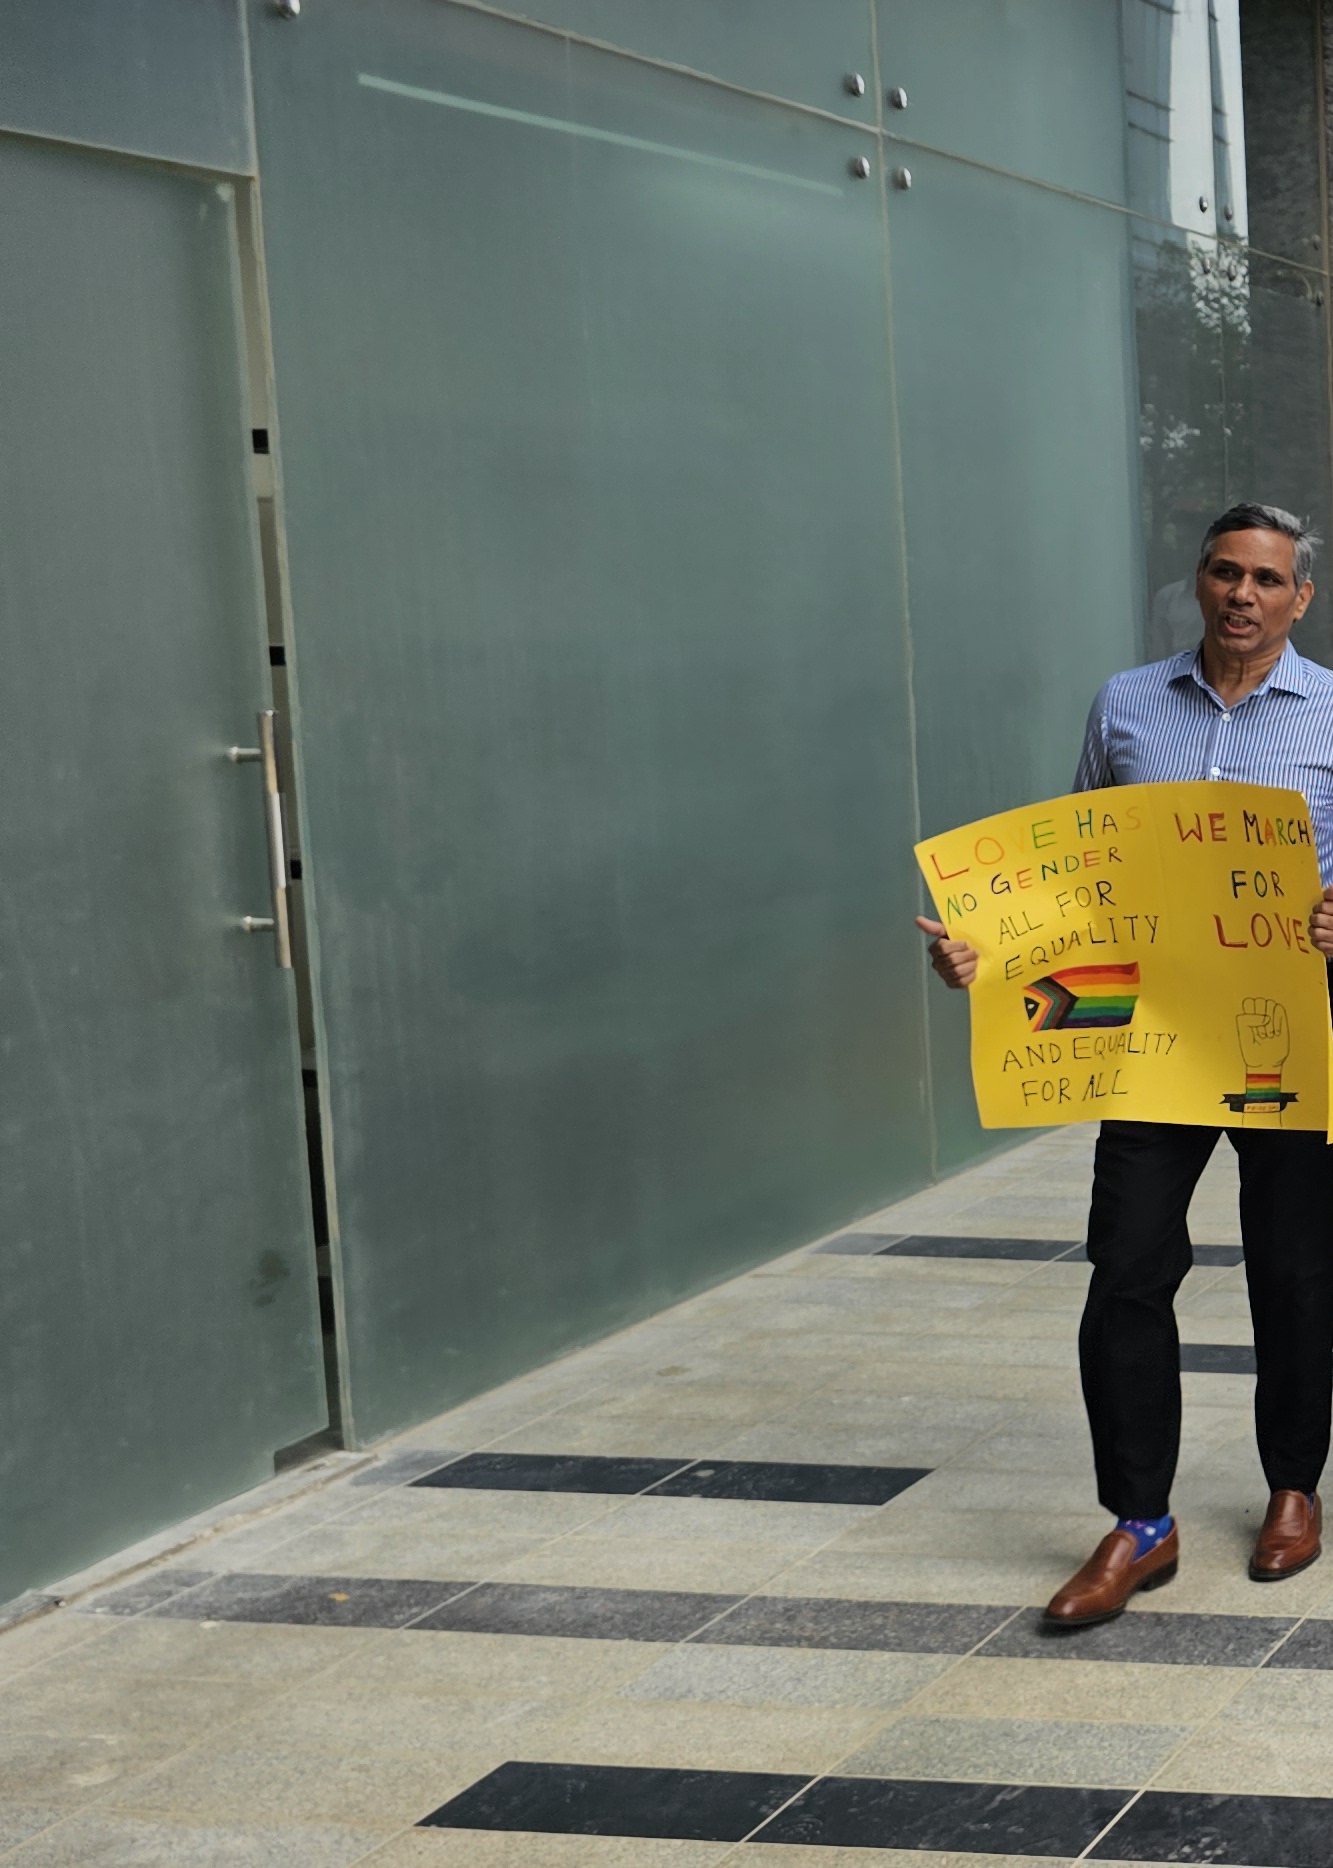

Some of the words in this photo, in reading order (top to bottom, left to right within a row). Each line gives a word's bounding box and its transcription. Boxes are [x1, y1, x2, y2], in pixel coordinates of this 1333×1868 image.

[929, 819, 1056, 880] LOVE
[1075, 806, 1142, 839] HAS
[1173, 812, 1228, 844] WE
[1242, 809, 1310, 848] MARCH
[945, 891, 978, 924] NO
[990, 845, 1123, 896] GENDER
[1231, 870, 1285, 899] FOR
[997, 911, 1044, 945] ALL
[1055, 880, 1117, 919] FOR
[1213, 912, 1310, 955] LOVE
[1004, 914, 1160, 981] EQUALITY
[1002, 1042, 1062, 1072] AND
[1073, 1032, 1179, 1061] EQUALITY
[1021, 1076, 1071, 1107] FOR
[1082, 1069, 1129, 1099] ALL
